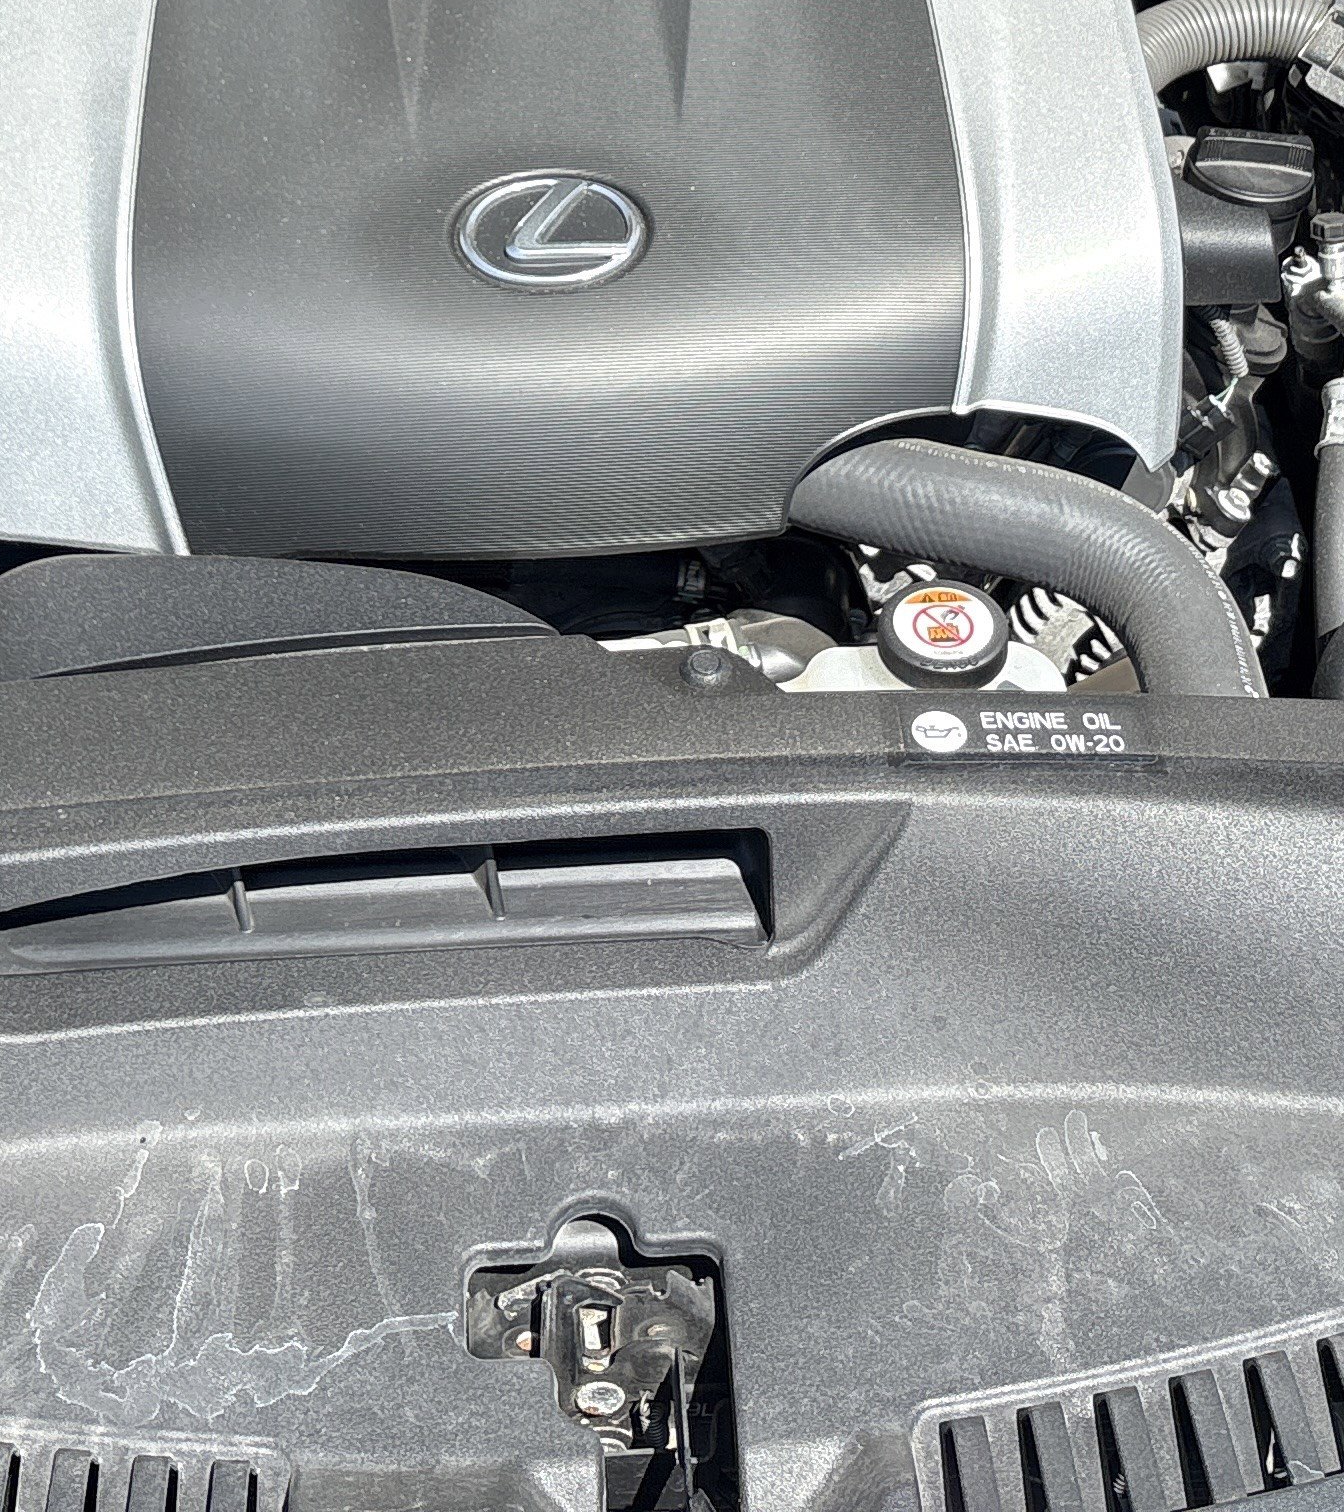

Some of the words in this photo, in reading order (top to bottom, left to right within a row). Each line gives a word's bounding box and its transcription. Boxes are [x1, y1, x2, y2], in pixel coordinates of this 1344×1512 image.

[979, 711, 1067, 730] ENGINE
[1082, 712, 1122, 731] OIL
[986, 733, 1033, 752] SAE
[1051, 734, 1125, 752] 0W-20
